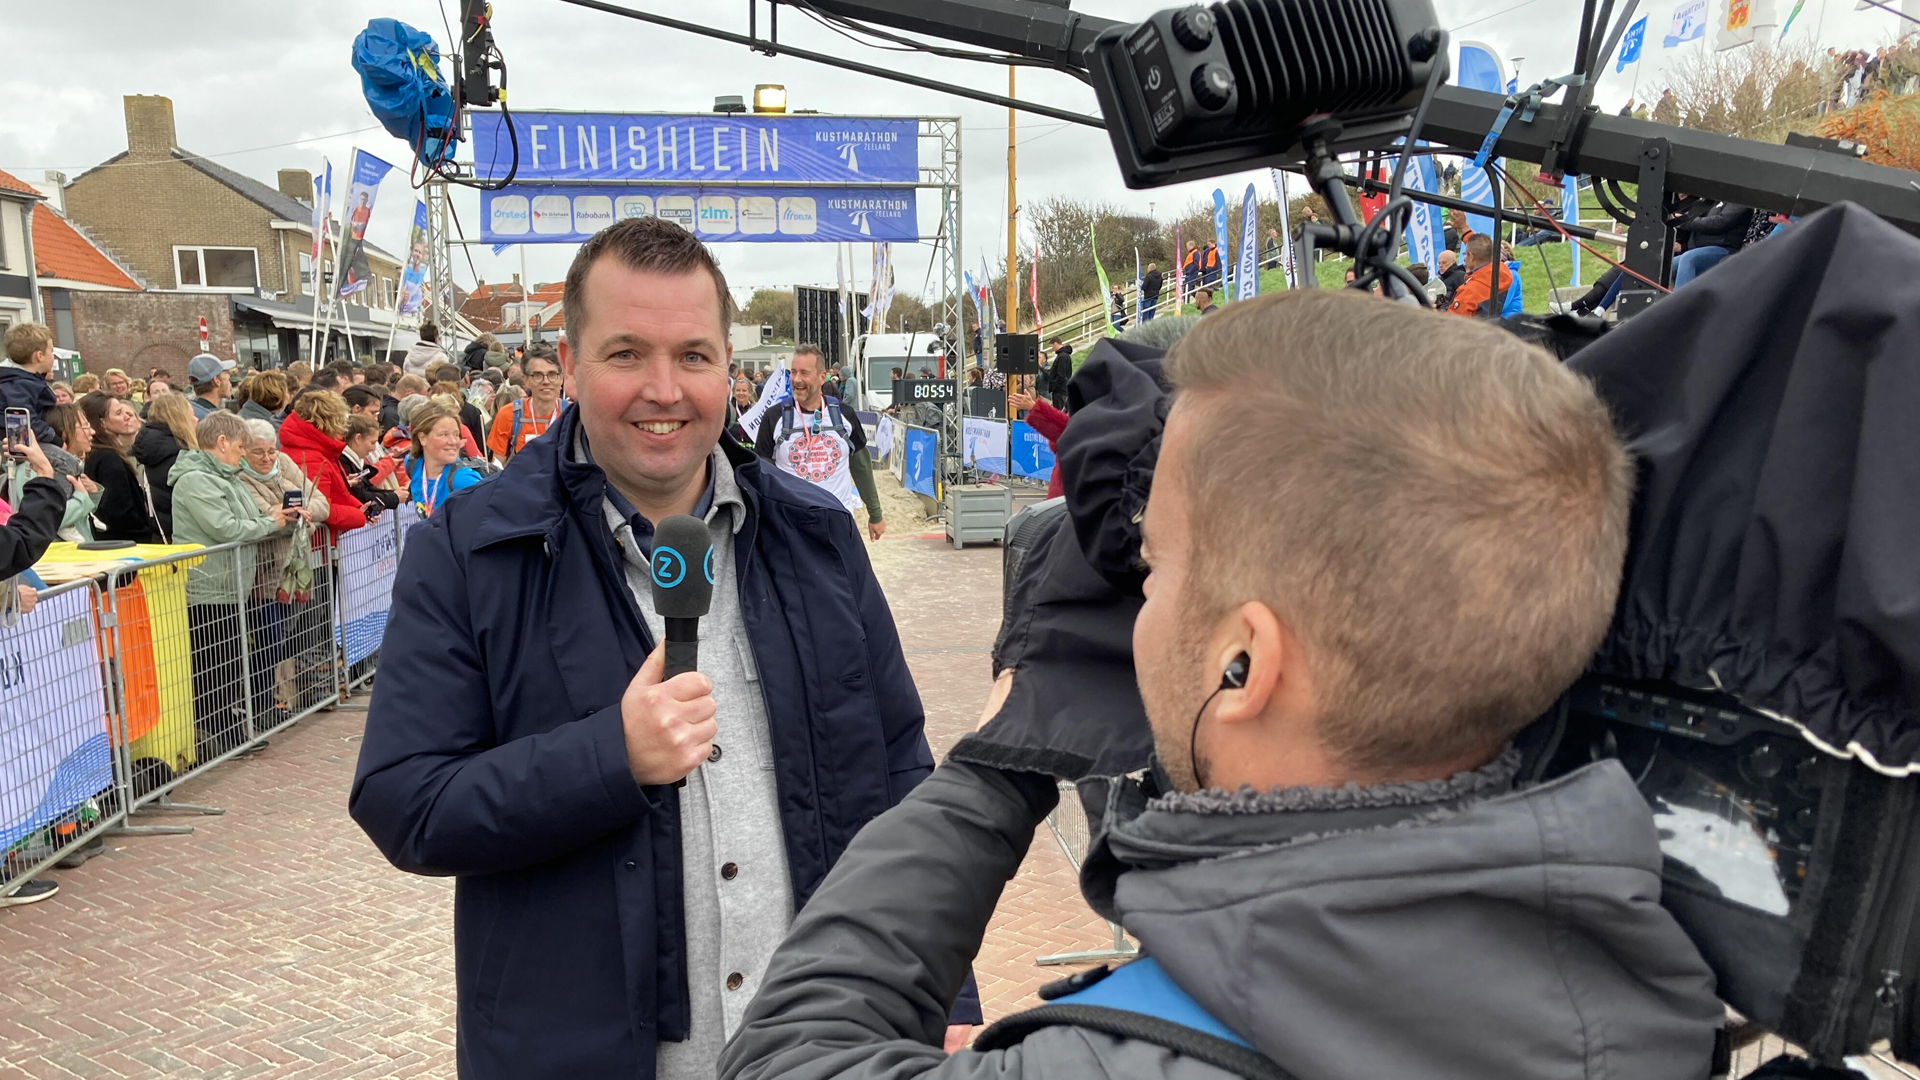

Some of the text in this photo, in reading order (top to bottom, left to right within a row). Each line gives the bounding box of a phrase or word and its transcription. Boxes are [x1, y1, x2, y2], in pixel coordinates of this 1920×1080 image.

[815, 131, 898, 143] KUSTMARATHON
[530, 124, 780, 172] FINISHLEIN
[863, 143, 891, 151] ZEELAND
[827, 199, 908, 211] KUSTMARATHON
[576, 211, 611, 219] Rabobank
[875, 210, 902, 218] ZEELAND
[914, 384, 954, 398] 8:05:54
